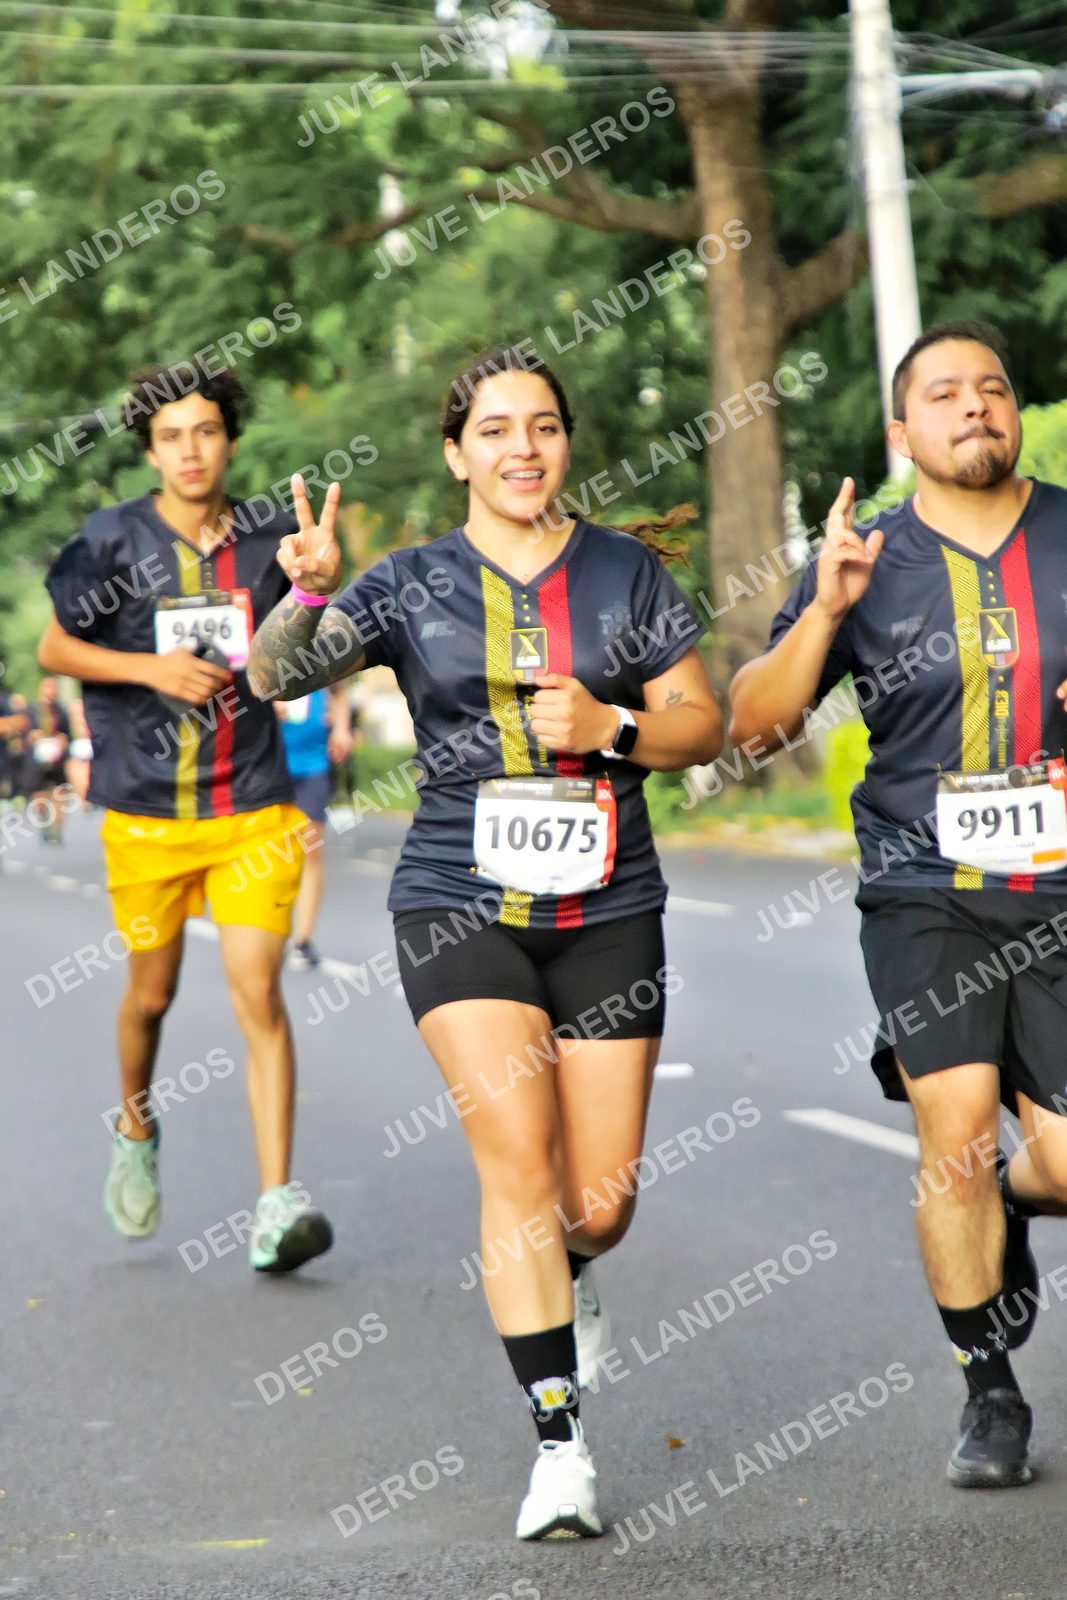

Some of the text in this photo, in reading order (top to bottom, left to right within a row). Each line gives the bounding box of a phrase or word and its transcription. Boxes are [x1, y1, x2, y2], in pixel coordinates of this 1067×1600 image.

[172, 615, 232, 645] 9496
[486, 814, 598, 853] 10675
[958, 800, 1045, 841] 9911
